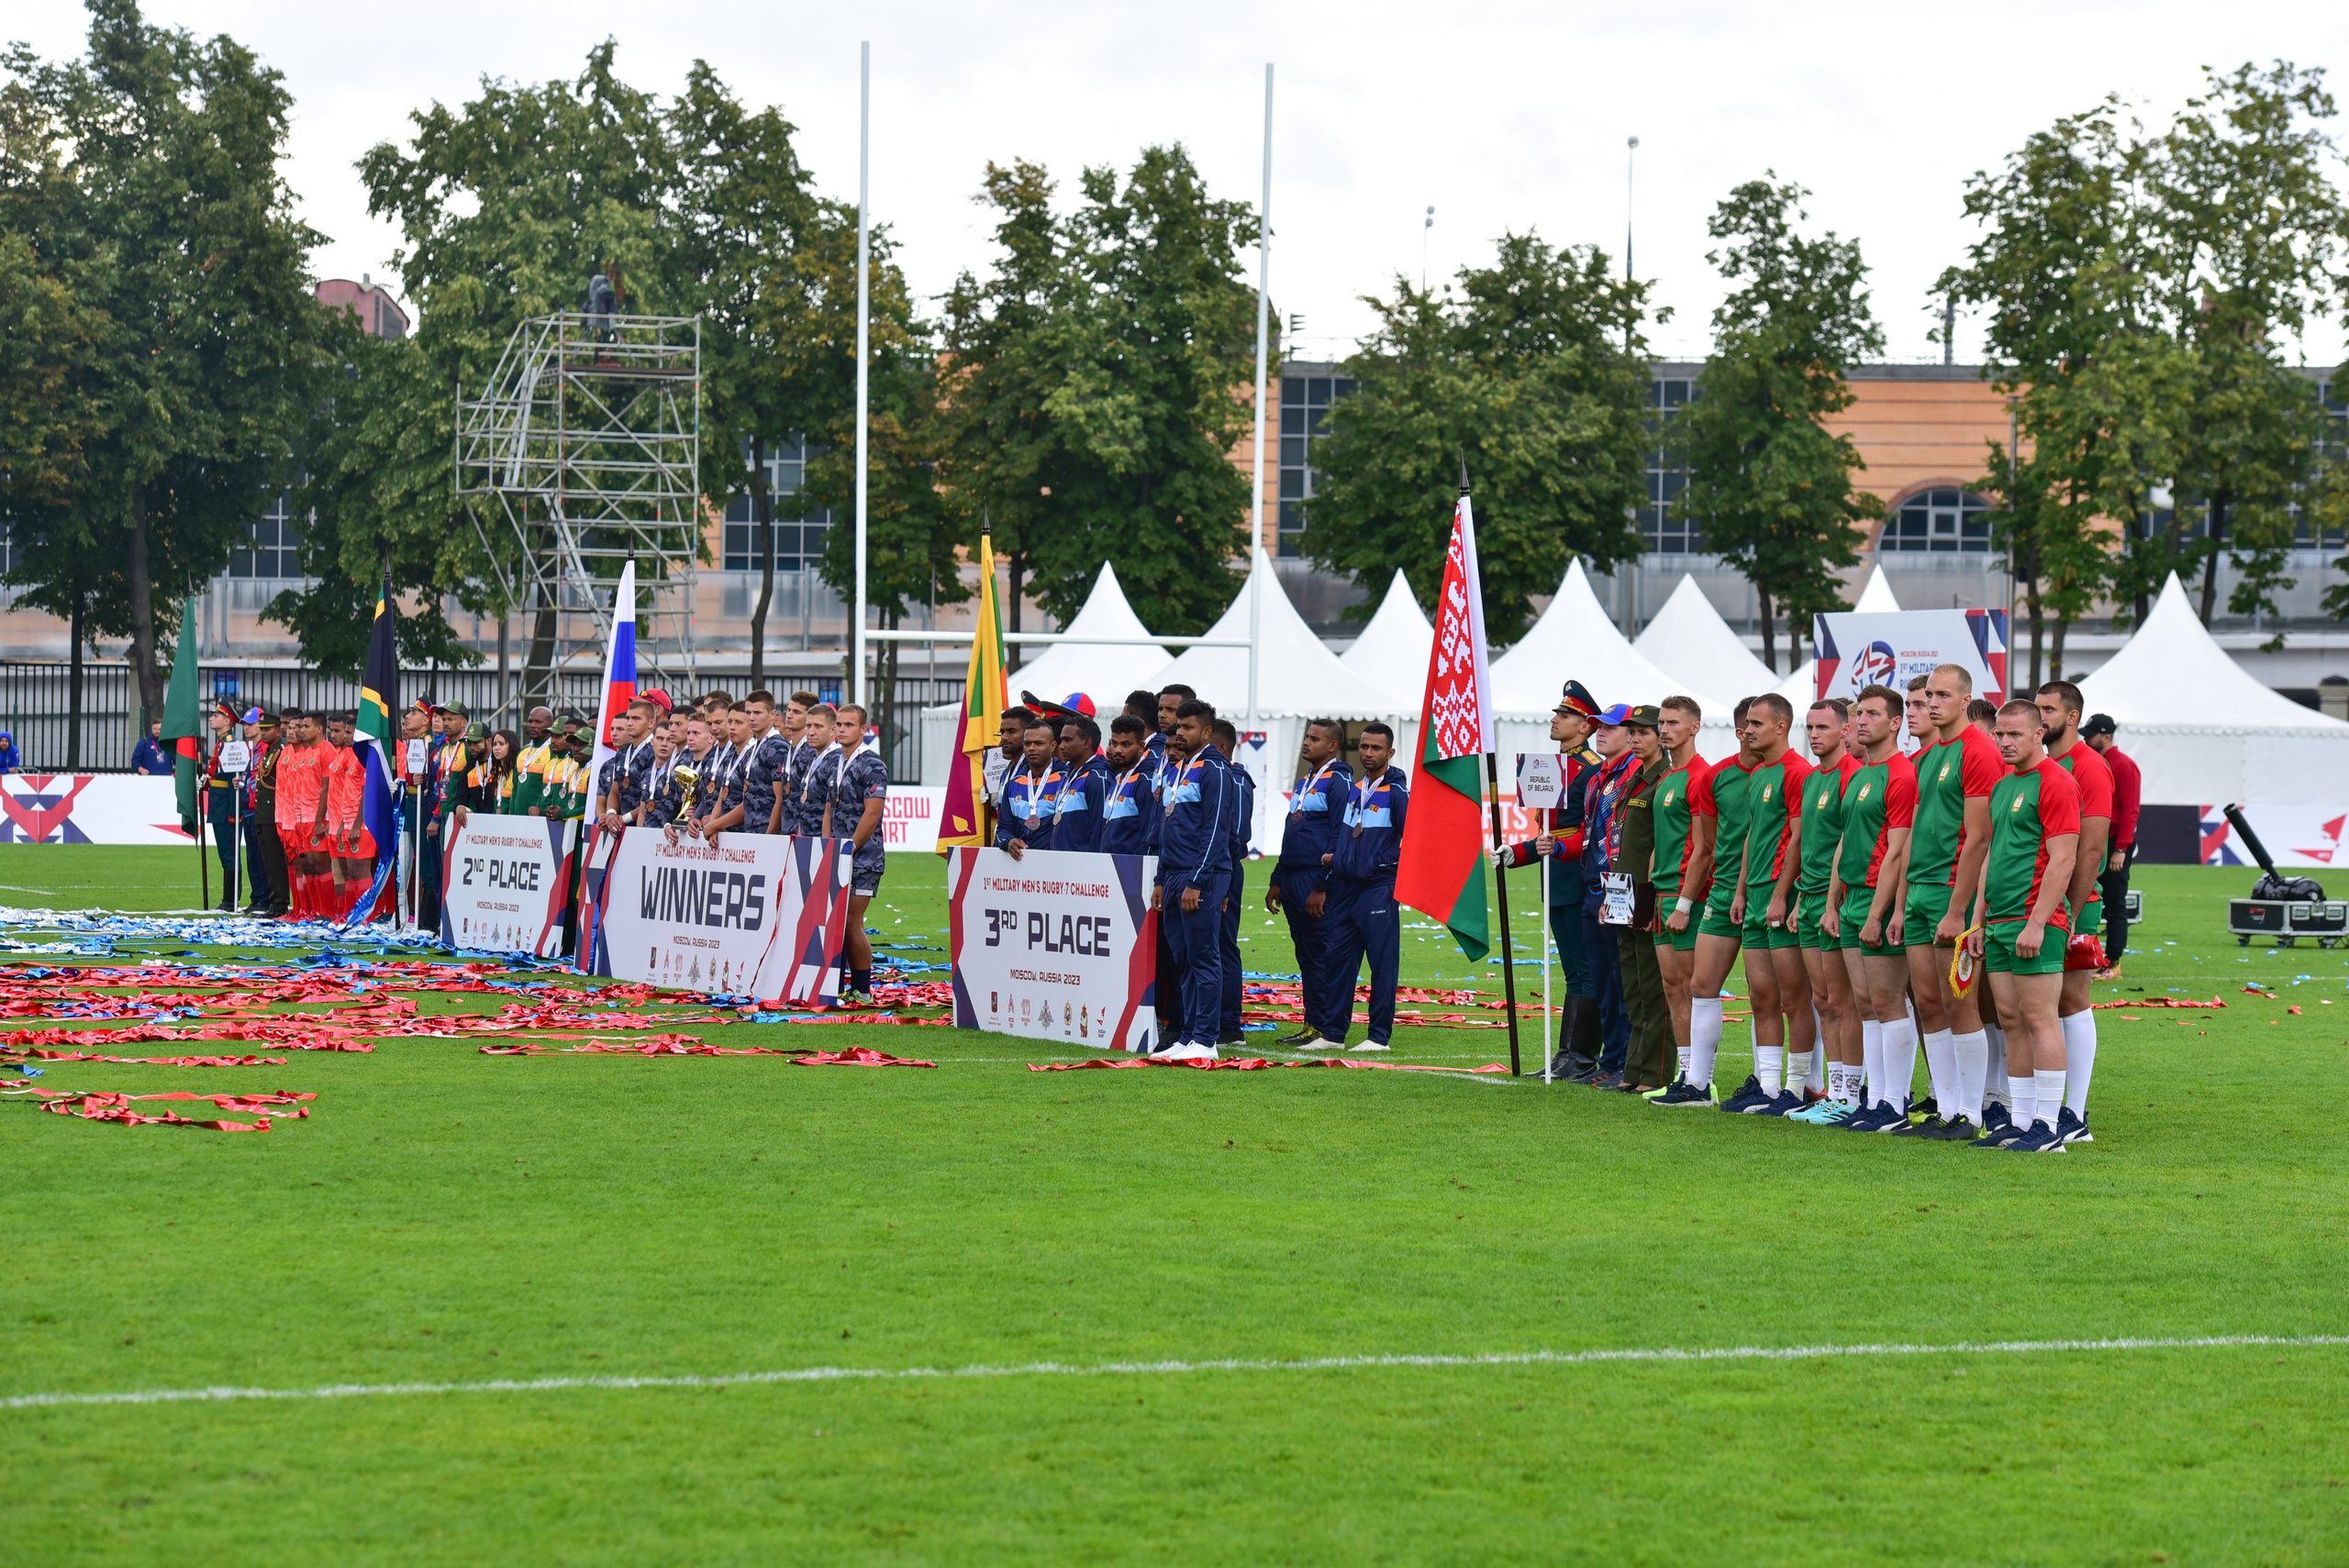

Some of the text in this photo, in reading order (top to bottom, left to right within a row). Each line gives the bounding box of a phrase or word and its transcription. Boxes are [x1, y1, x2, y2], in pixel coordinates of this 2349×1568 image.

[471, 834, 488, 846] MILITARY
[518, 838, 543, 850] CHALLENGE
[662, 843, 685, 859] MILITARY
[725, 848, 756, 863] CHALLENGE
[462, 857, 541, 891] 2ND PLACE
[640, 864, 765, 931] WINNERS
[992, 877, 1020, 893] MILITARY
[1070, 882, 1109, 898] CHALLENGE
[494, 902, 507, 911] RUSSIA
[508, 904, 519, 912] 2023
[673, 935, 720, 949] MOSCOW, RUSSIA 2023
[985, 908, 1111, 957] 3RD PLACE
[1010, 968, 1081, 985] MOSCOW, RUSSIA 2023
